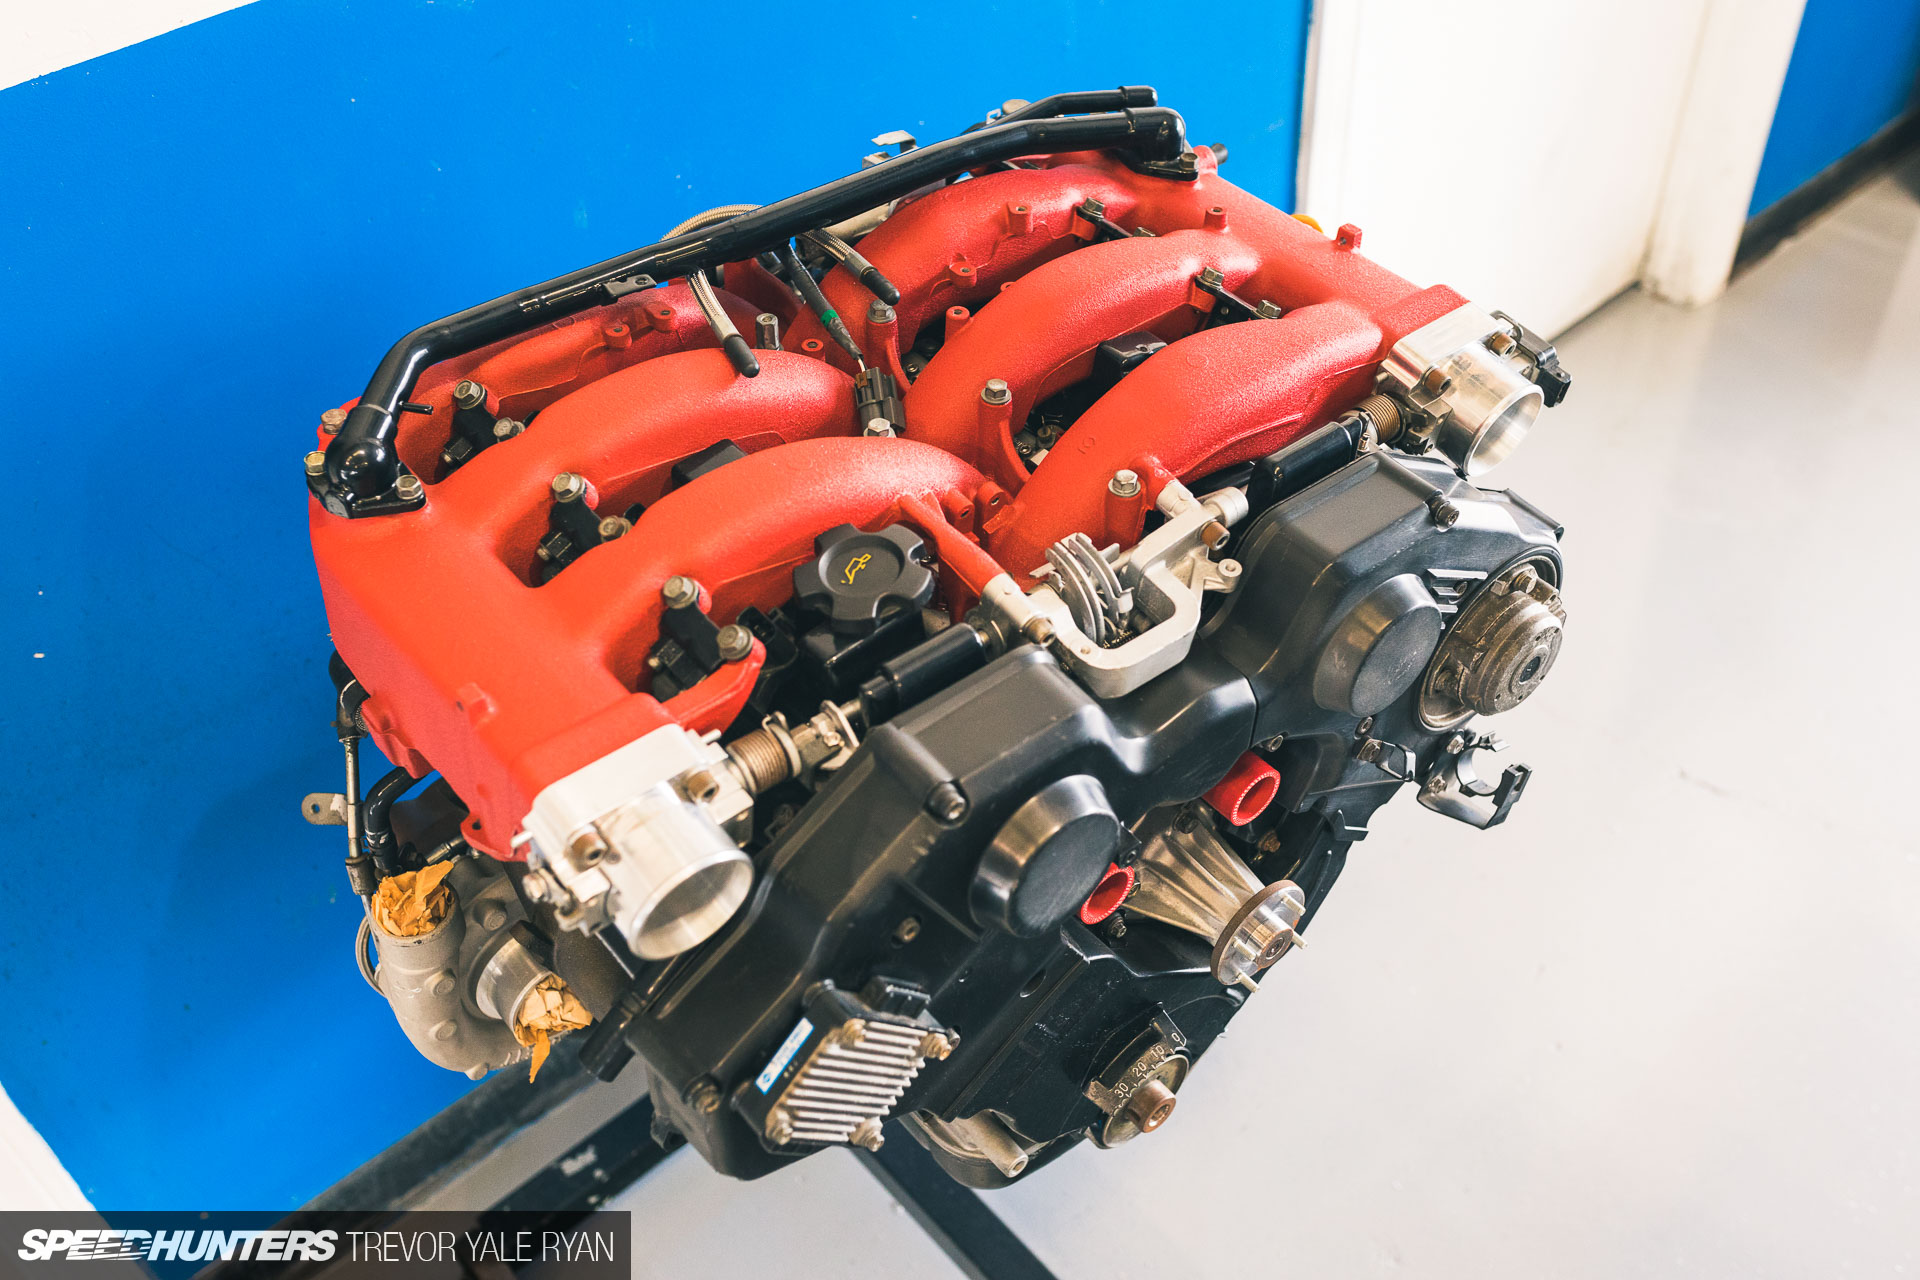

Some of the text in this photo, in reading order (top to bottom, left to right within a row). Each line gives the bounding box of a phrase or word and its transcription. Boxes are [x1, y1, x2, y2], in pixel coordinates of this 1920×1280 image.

[1114, 1032, 1181, 1098] 30 20 10 0
